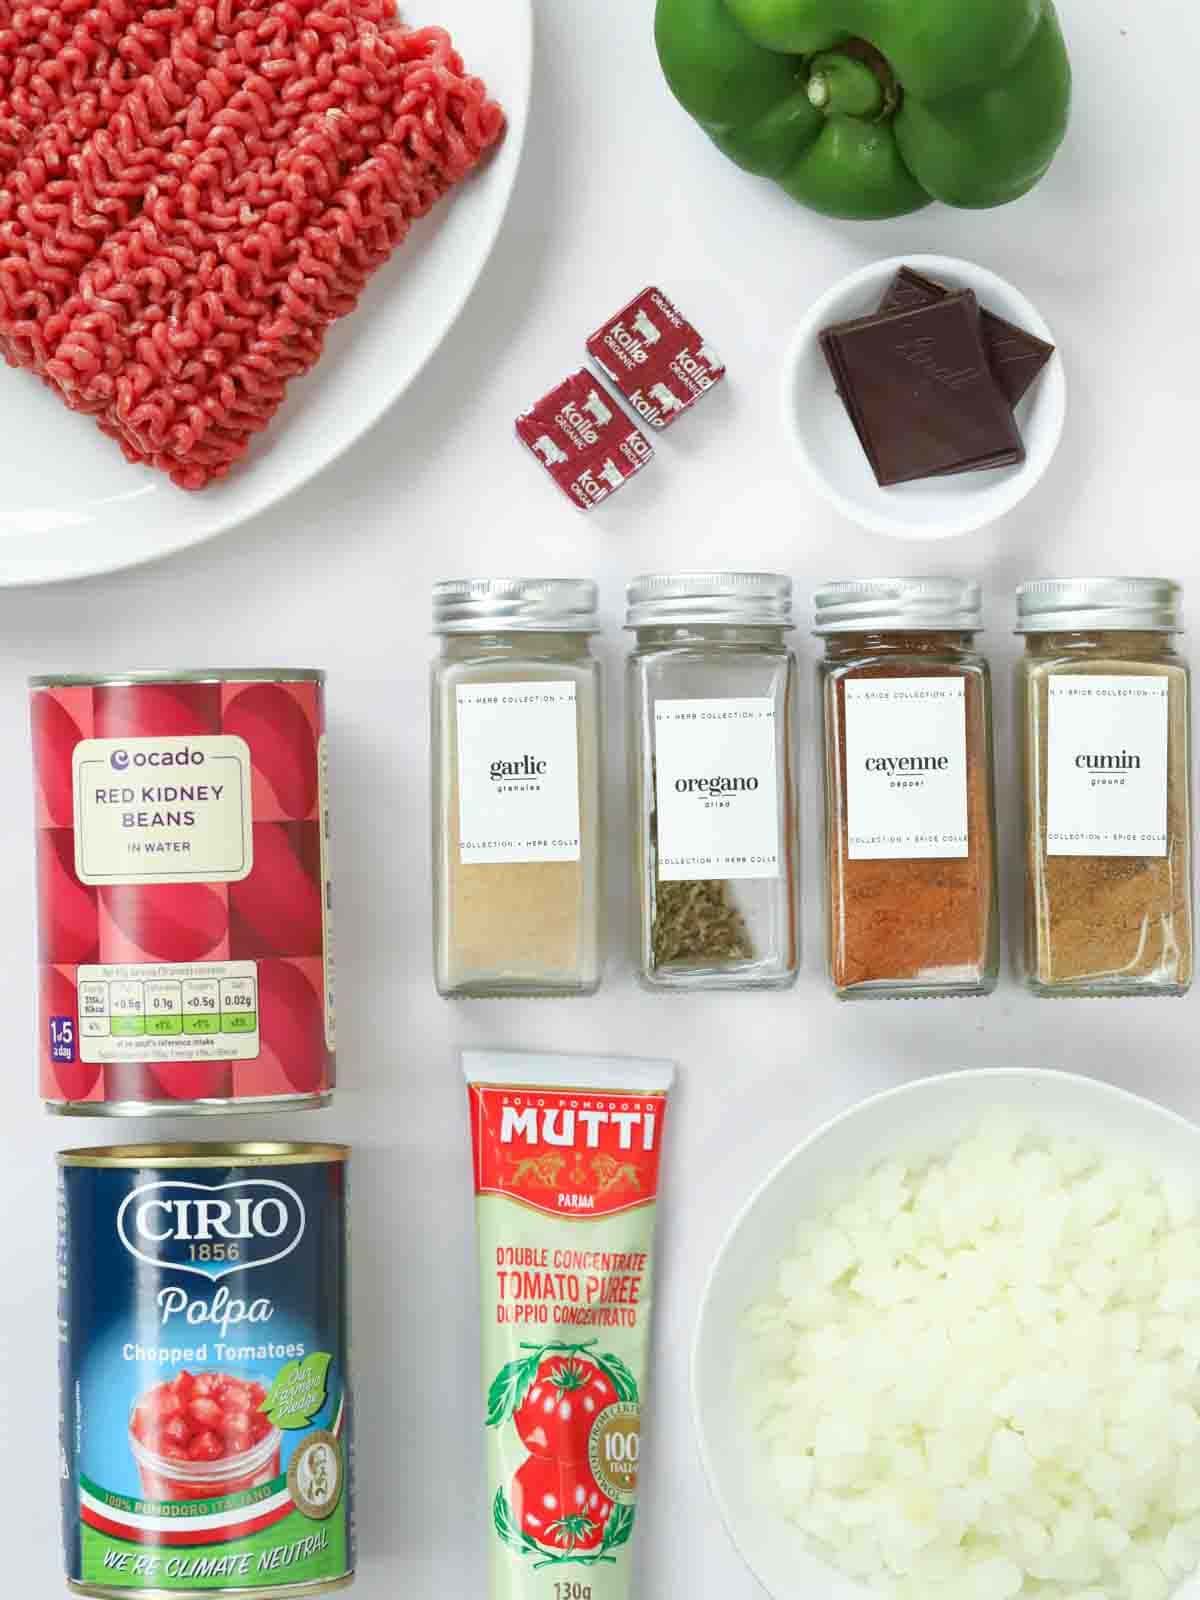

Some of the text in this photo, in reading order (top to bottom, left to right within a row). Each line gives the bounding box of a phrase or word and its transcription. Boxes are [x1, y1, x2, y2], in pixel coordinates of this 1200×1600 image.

[476, 695, 555, 704] HERB COLLECTION
[893, 691, 945, 699] COLLECTION
[1095, 689, 1149, 697] COLLECTION
[700, 712, 754, 720] COLLECTION
[133, 746, 205, 767] ocado
[865, 755, 949, 777] cayenne
[1074, 749, 1141, 769] cumin
[489, 754, 547, 781] garlic
[497, 784, 541, 793] granules
[674, 775, 759, 798] oregano
[889, 780, 924, 789] pepper
[1090, 778, 1126, 787] ground
[95, 784, 224, 804] RED KIDNEY
[121, 811, 196, 828] BEANS
[127, 841, 191, 853] IN WATER
[187, 996, 215, 1009] <0.5g
[225, 995, 251, 1007] 0.02g
[50, 1020, 57, 1043] 1
[62, 1021, 73, 1043] 5
[58, 1044, 72, 1059] day
[502, 1096, 655, 1112] SOLO POMODORO
[500, 1106, 656, 1151] MUTTI
[557, 1193, 594, 1209] PARMA
[136, 1197, 288, 1240] CIRIO
[188, 1242, 241, 1262] 1856
[496, 1247, 648, 1272] DOUBLE CONCENTRATE
[496, 1271, 642, 1305] TOMATO PUREE
[157, 1285, 274, 1338] Polpa
[553, 1305, 637, 1328] CONCENTRATO
[122, 1342, 305, 1366] Chopped Tomatoes
[133, 1501, 208, 1517] POMODORO
[211, 1486, 272, 1513] ITALIANO
[103, 1527, 330, 1580] WE'RE CLIMATE NEUTRAL
[553, 1582, 592, 1600] 130g
